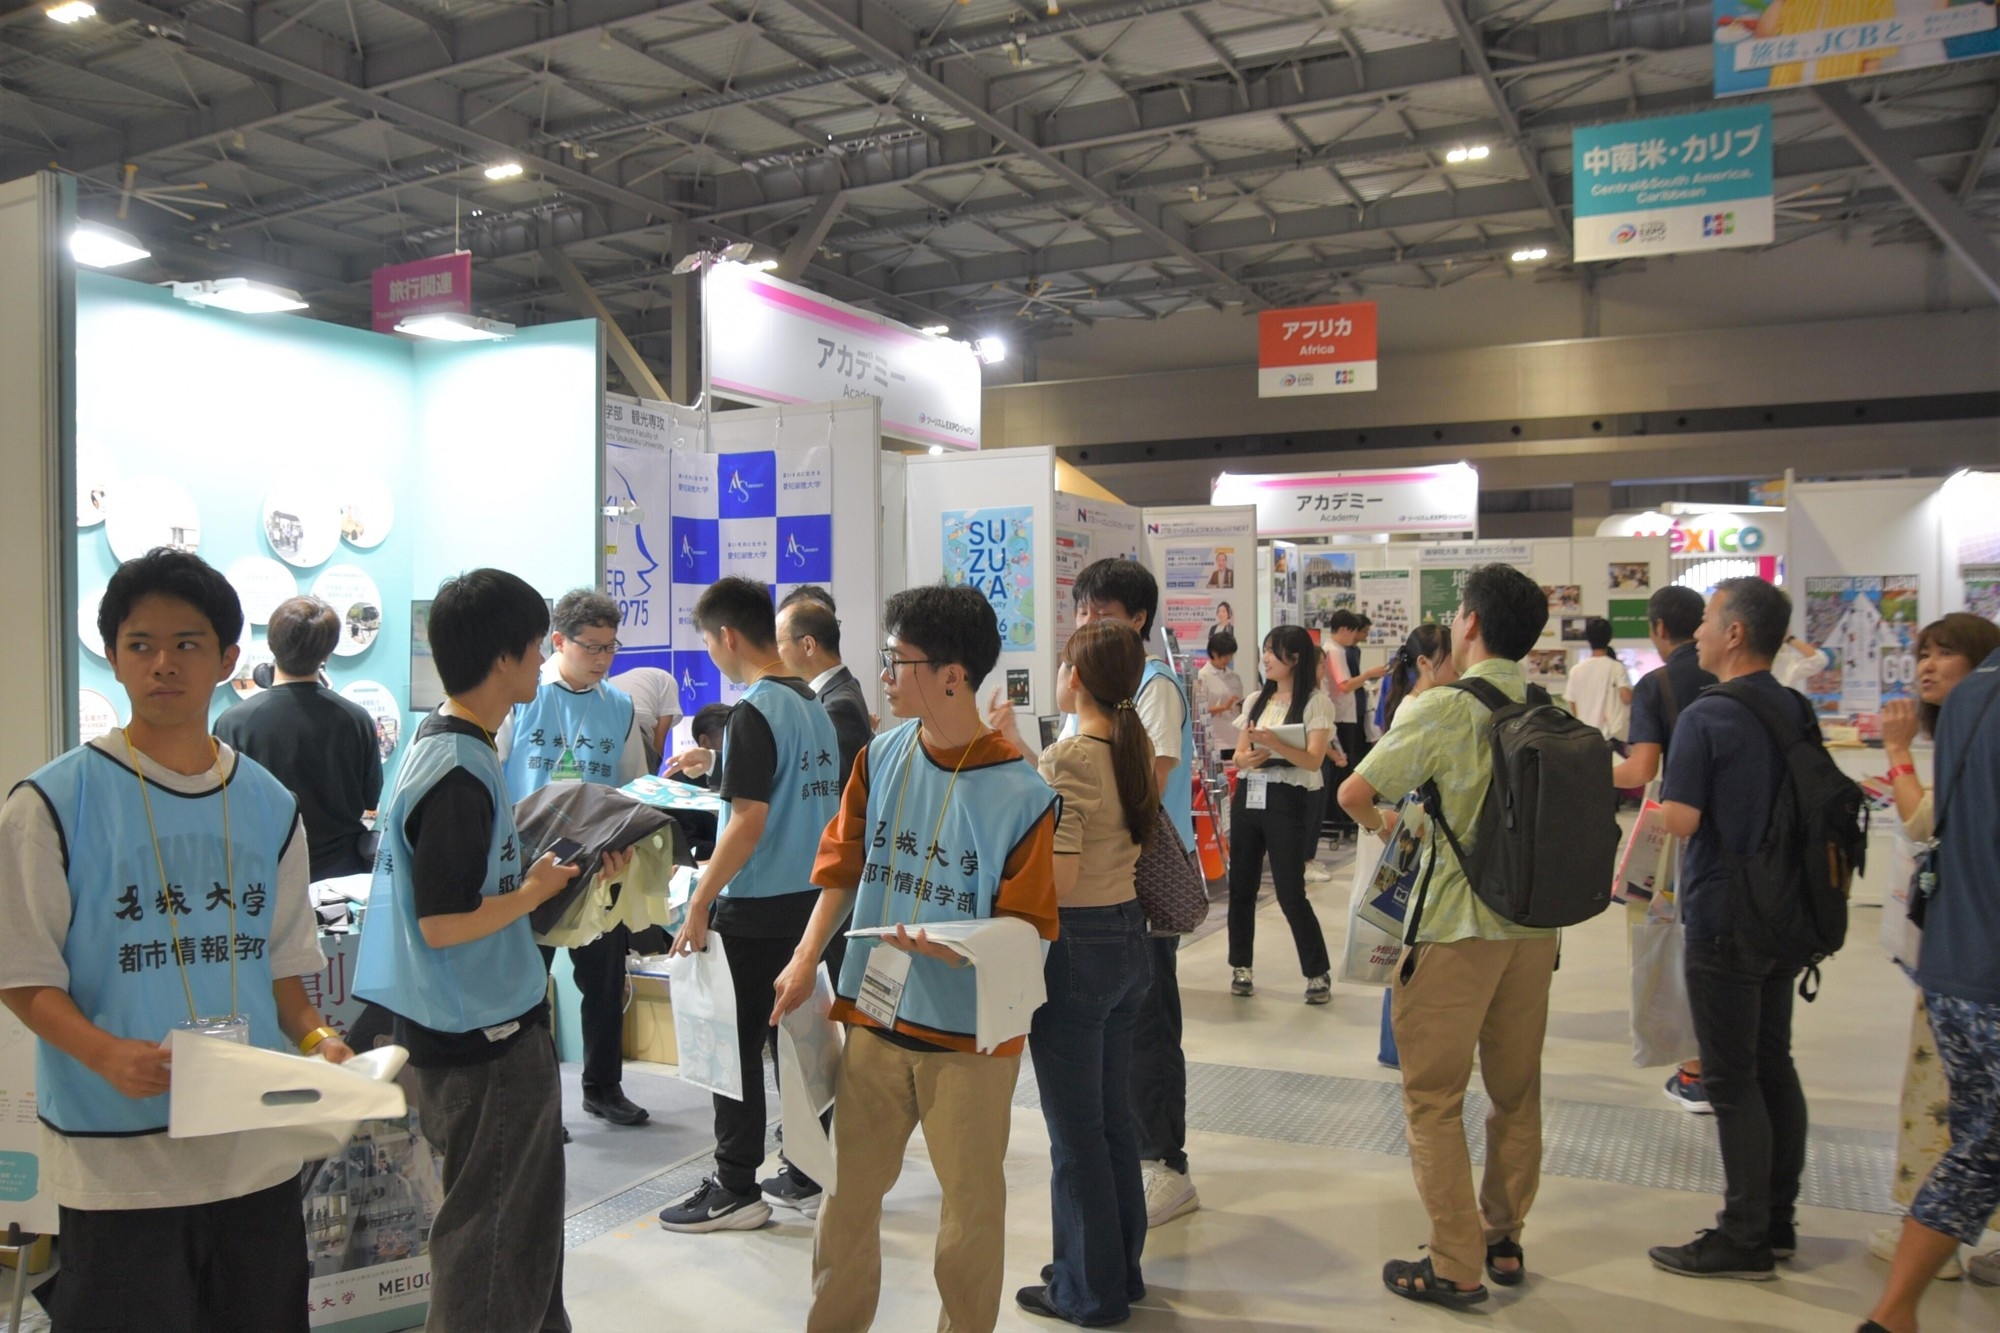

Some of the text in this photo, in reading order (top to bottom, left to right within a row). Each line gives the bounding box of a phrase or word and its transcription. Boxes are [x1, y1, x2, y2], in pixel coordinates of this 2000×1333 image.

[1583, 124, 1763, 176] 中南米・カリブ
[389, 271, 453, 303] 旅行関連
[1282, 318, 1352, 341] アフリカ
[817, 337, 906, 389] アカデミー
[1299, 345, 1335, 356] Africa
[632, 410, 666, 431] 観光専攻
[1297, 492, 1383, 512] アカデミー
[1320, 513, 1360, 523] Academy
[969, 519, 1006, 545] SU
[969, 548, 1006, 573] ZU
[615, 600, 649, 627] 975
[530, 729, 615, 754] 名城大学
[873, 821, 978, 877] 名城大学
[114, 882, 267, 921] 名城大学
